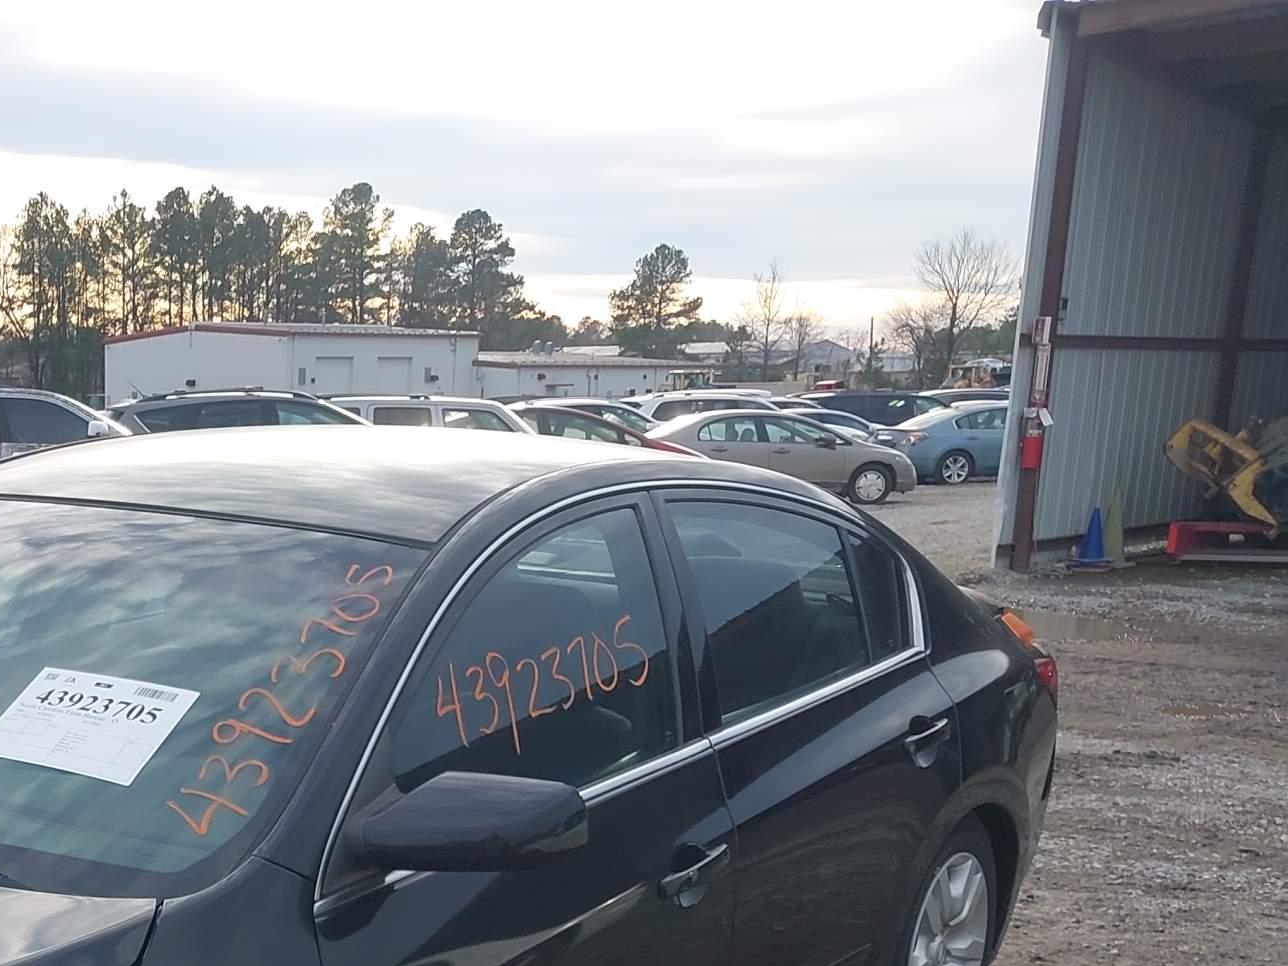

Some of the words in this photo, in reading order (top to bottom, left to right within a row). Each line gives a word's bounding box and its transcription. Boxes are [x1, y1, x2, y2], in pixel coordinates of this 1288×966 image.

[35, 687, 163, 724] 43923705
[166, 564, 393, 836] 43923705
[436, 614, 649, 755] 43923705
